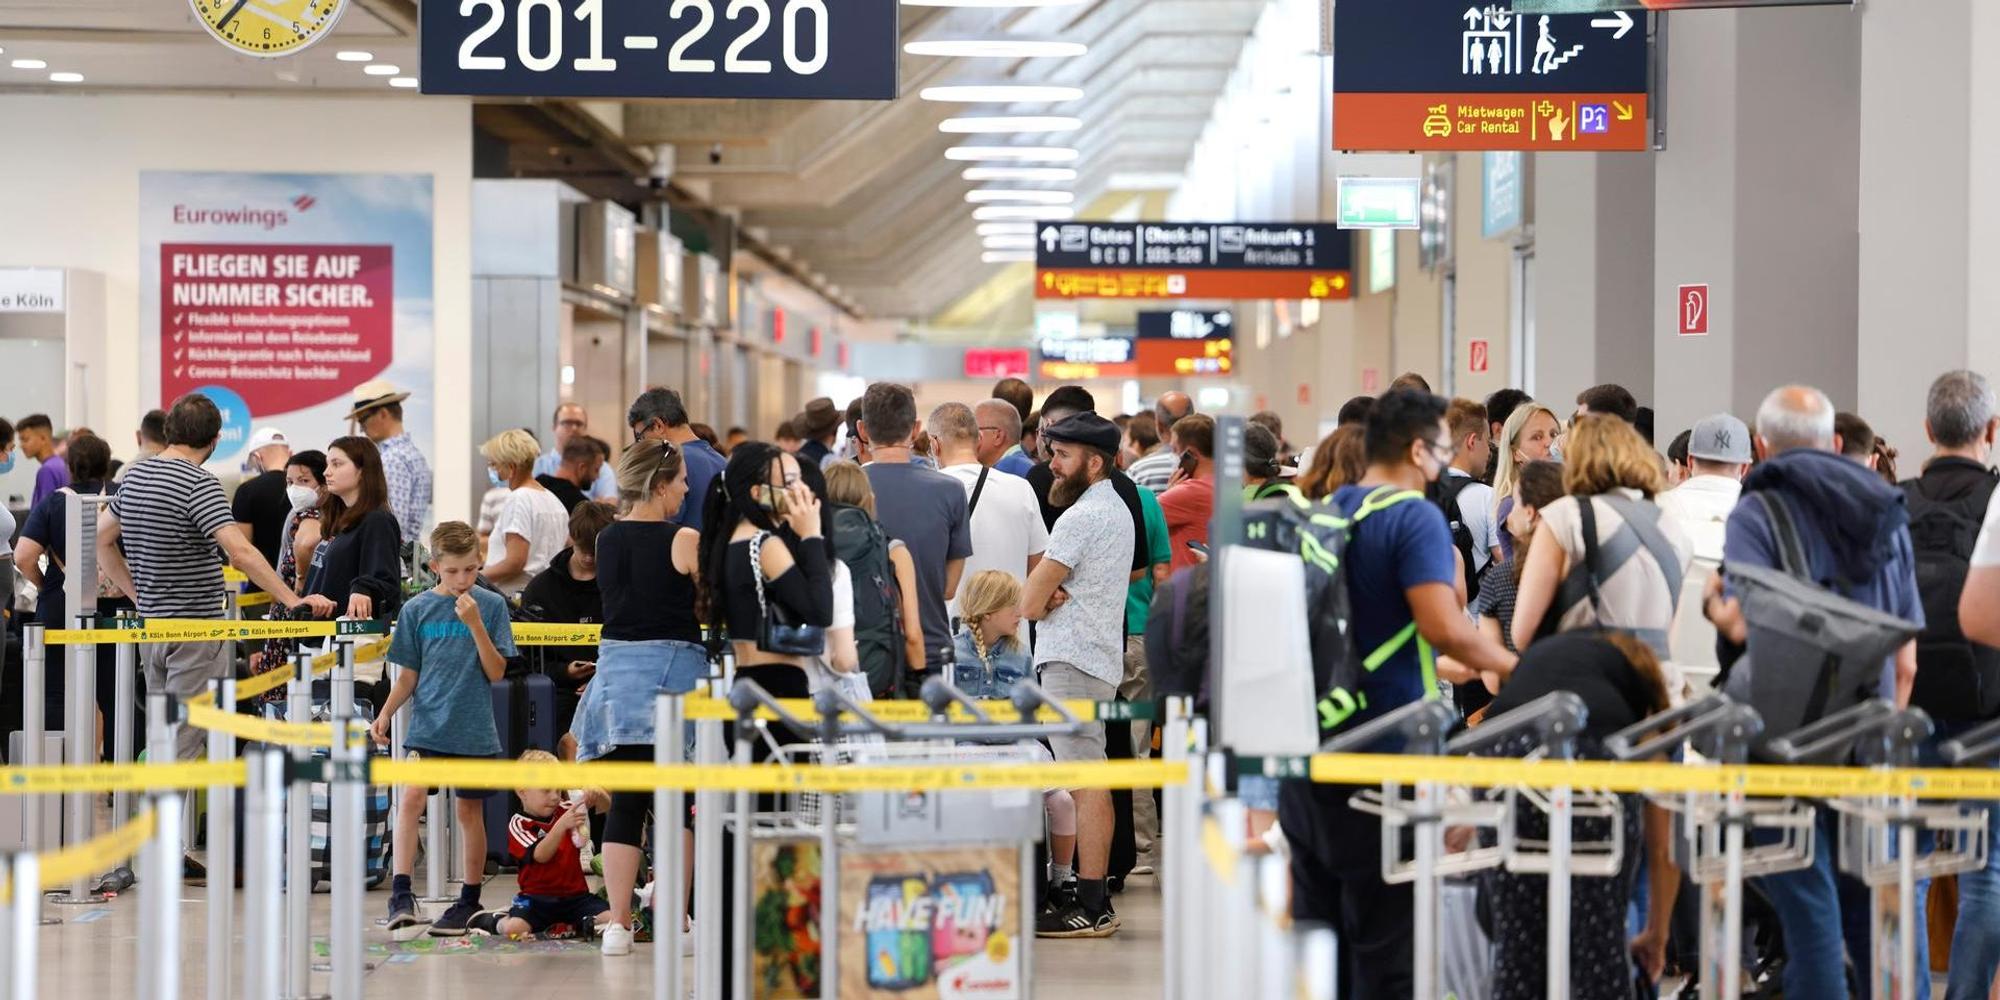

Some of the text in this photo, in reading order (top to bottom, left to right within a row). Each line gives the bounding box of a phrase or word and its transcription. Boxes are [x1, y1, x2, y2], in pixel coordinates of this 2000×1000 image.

[233, 20, 240, 33] 7
[263, 27, 271, 40] 6
[292, 21, 300, 34] 5
[458, 0, 829, 75] 201-220
[1457, 105, 1525, 119] Mietwagen
[1457, 121, 1520, 134] Car Rental
[173, 204, 288, 230] Eurowings
[172, 253, 361, 279] FLIEGEN SIE AUF
[16, 292, 55, 308] Köln
[172, 282, 374, 308] NUMMER SICHER.
[188, 311, 230, 327] Flexible
[245, 331, 264, 345] mit
[265, 331, 290, 345] dem
[276, 348, 303, 362] nach
[183, 630, 207, 638] Airport
[543, 634, 568, 642] Airport
[853, 893, 1006, 934] HAVE FUN!
